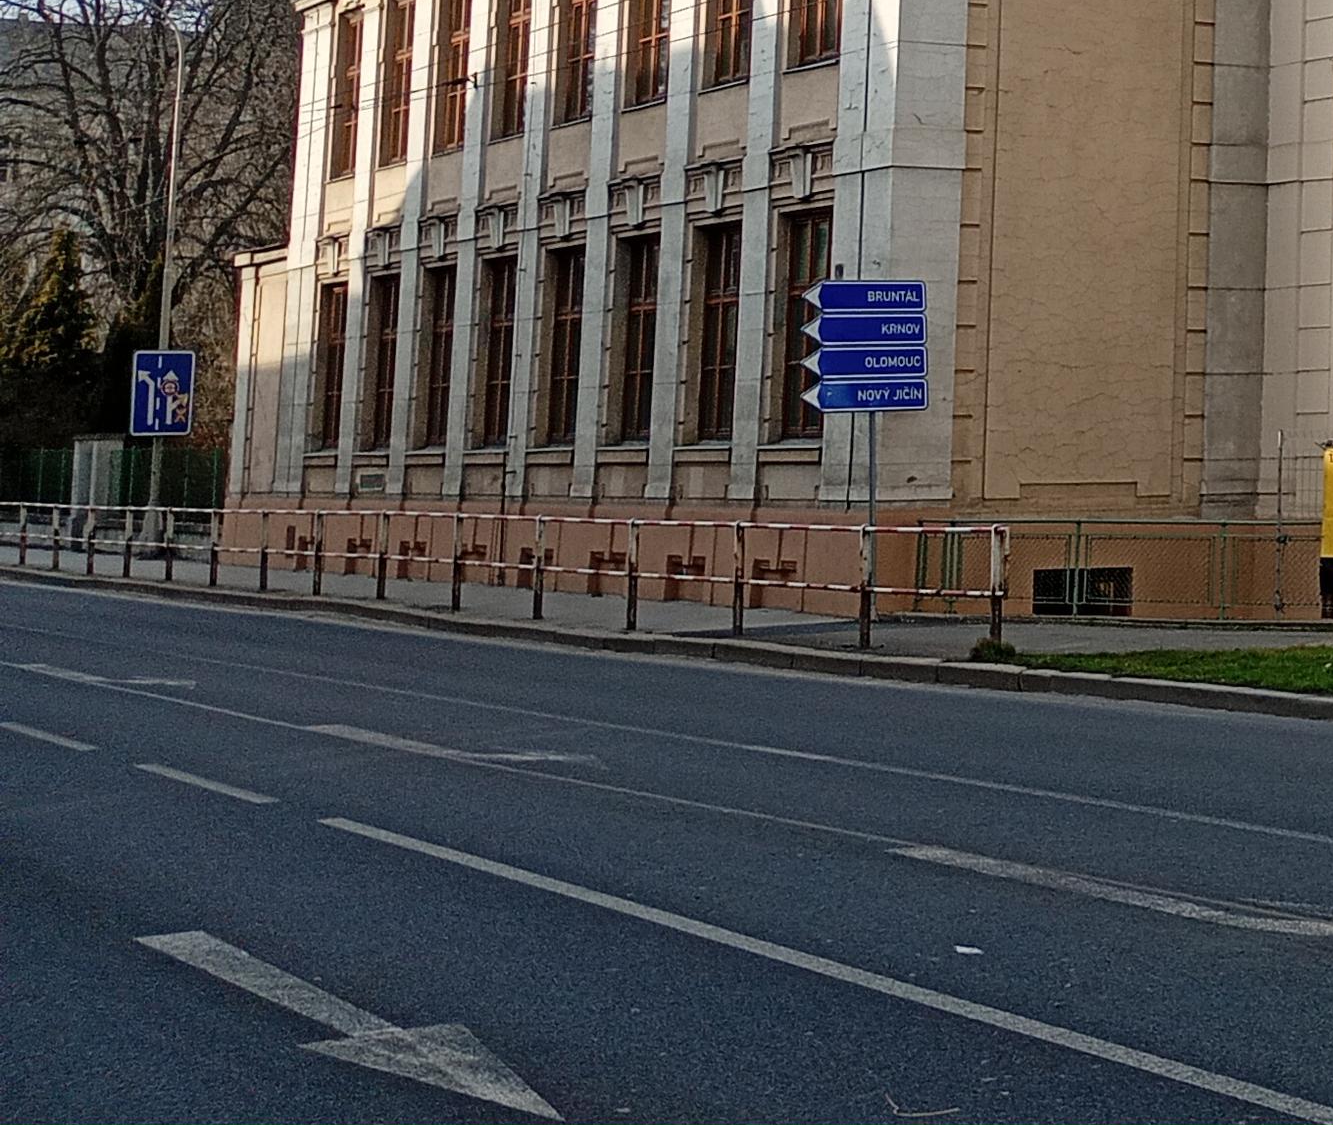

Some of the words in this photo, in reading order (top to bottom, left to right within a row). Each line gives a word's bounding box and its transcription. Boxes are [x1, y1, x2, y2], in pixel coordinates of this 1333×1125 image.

[867, 289, 920, 303] BRUNTÁL
[881, 323, 920, 335] KRNOV
[865, 356, 921, 368] OLOMOUC
[858, 387, 890, 401] NOVÝ
[893, 386, 922, 400] JIČÍN
